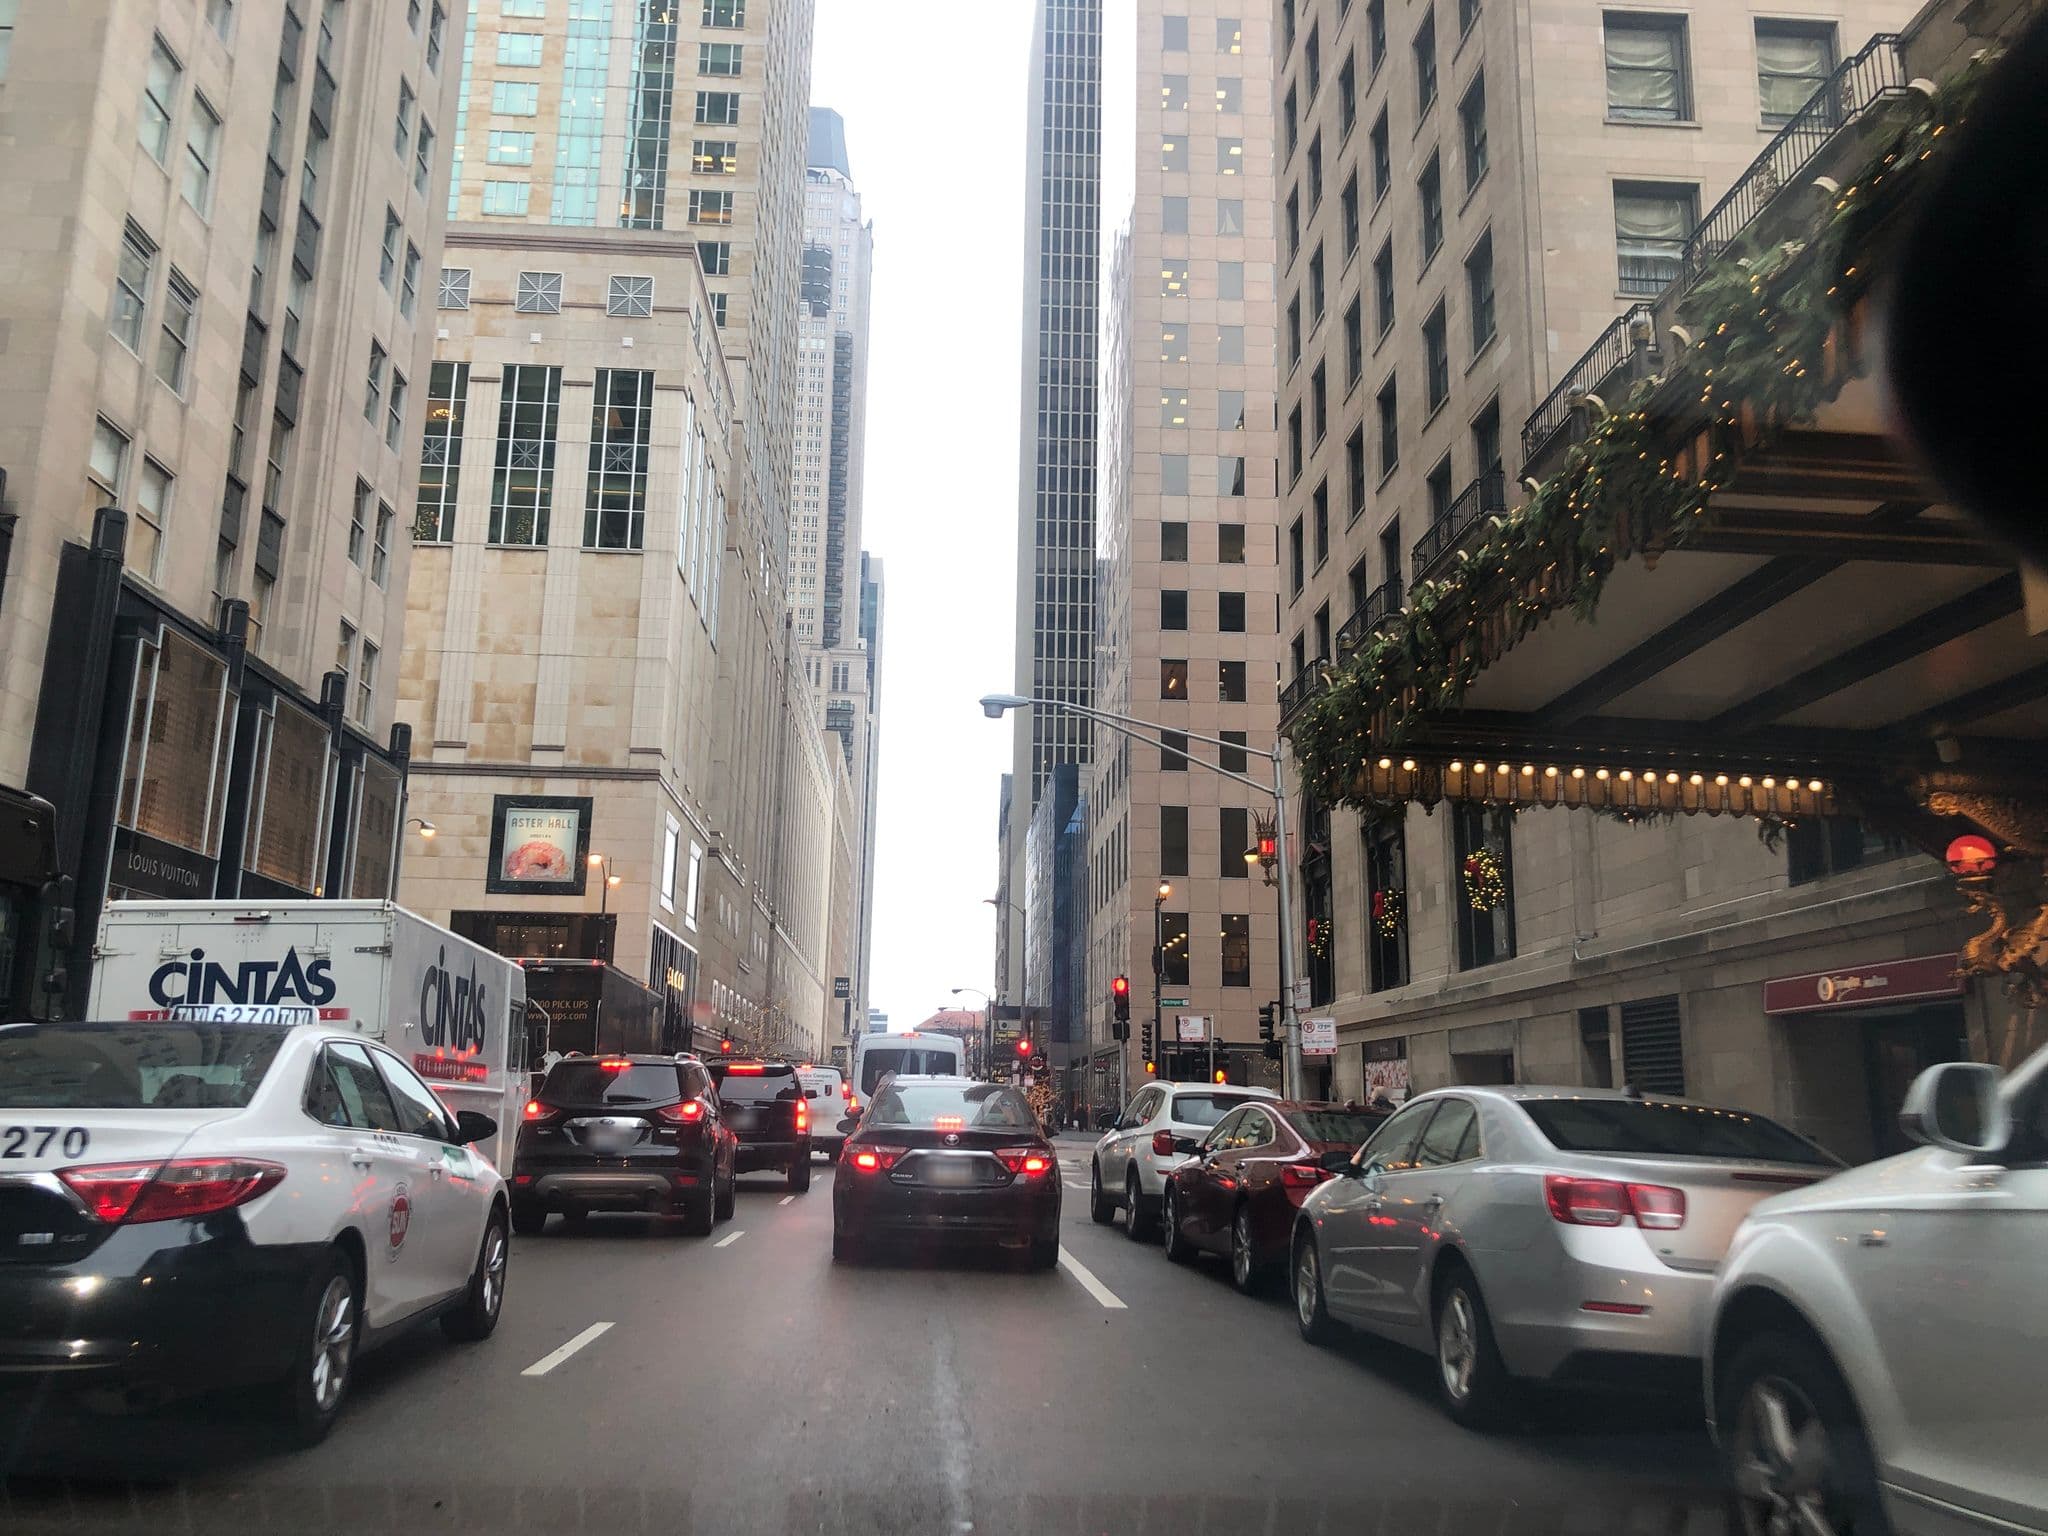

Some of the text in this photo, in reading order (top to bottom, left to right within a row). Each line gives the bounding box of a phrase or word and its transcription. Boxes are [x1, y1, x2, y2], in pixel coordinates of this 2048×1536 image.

[511, 817, 573, 829] ASTER HALL
[128, 852, 201, 888] LOUIS VUITTON
[552, 1001, 571, 1009] PICK
[573, 1000, 589, 1009] UPS
